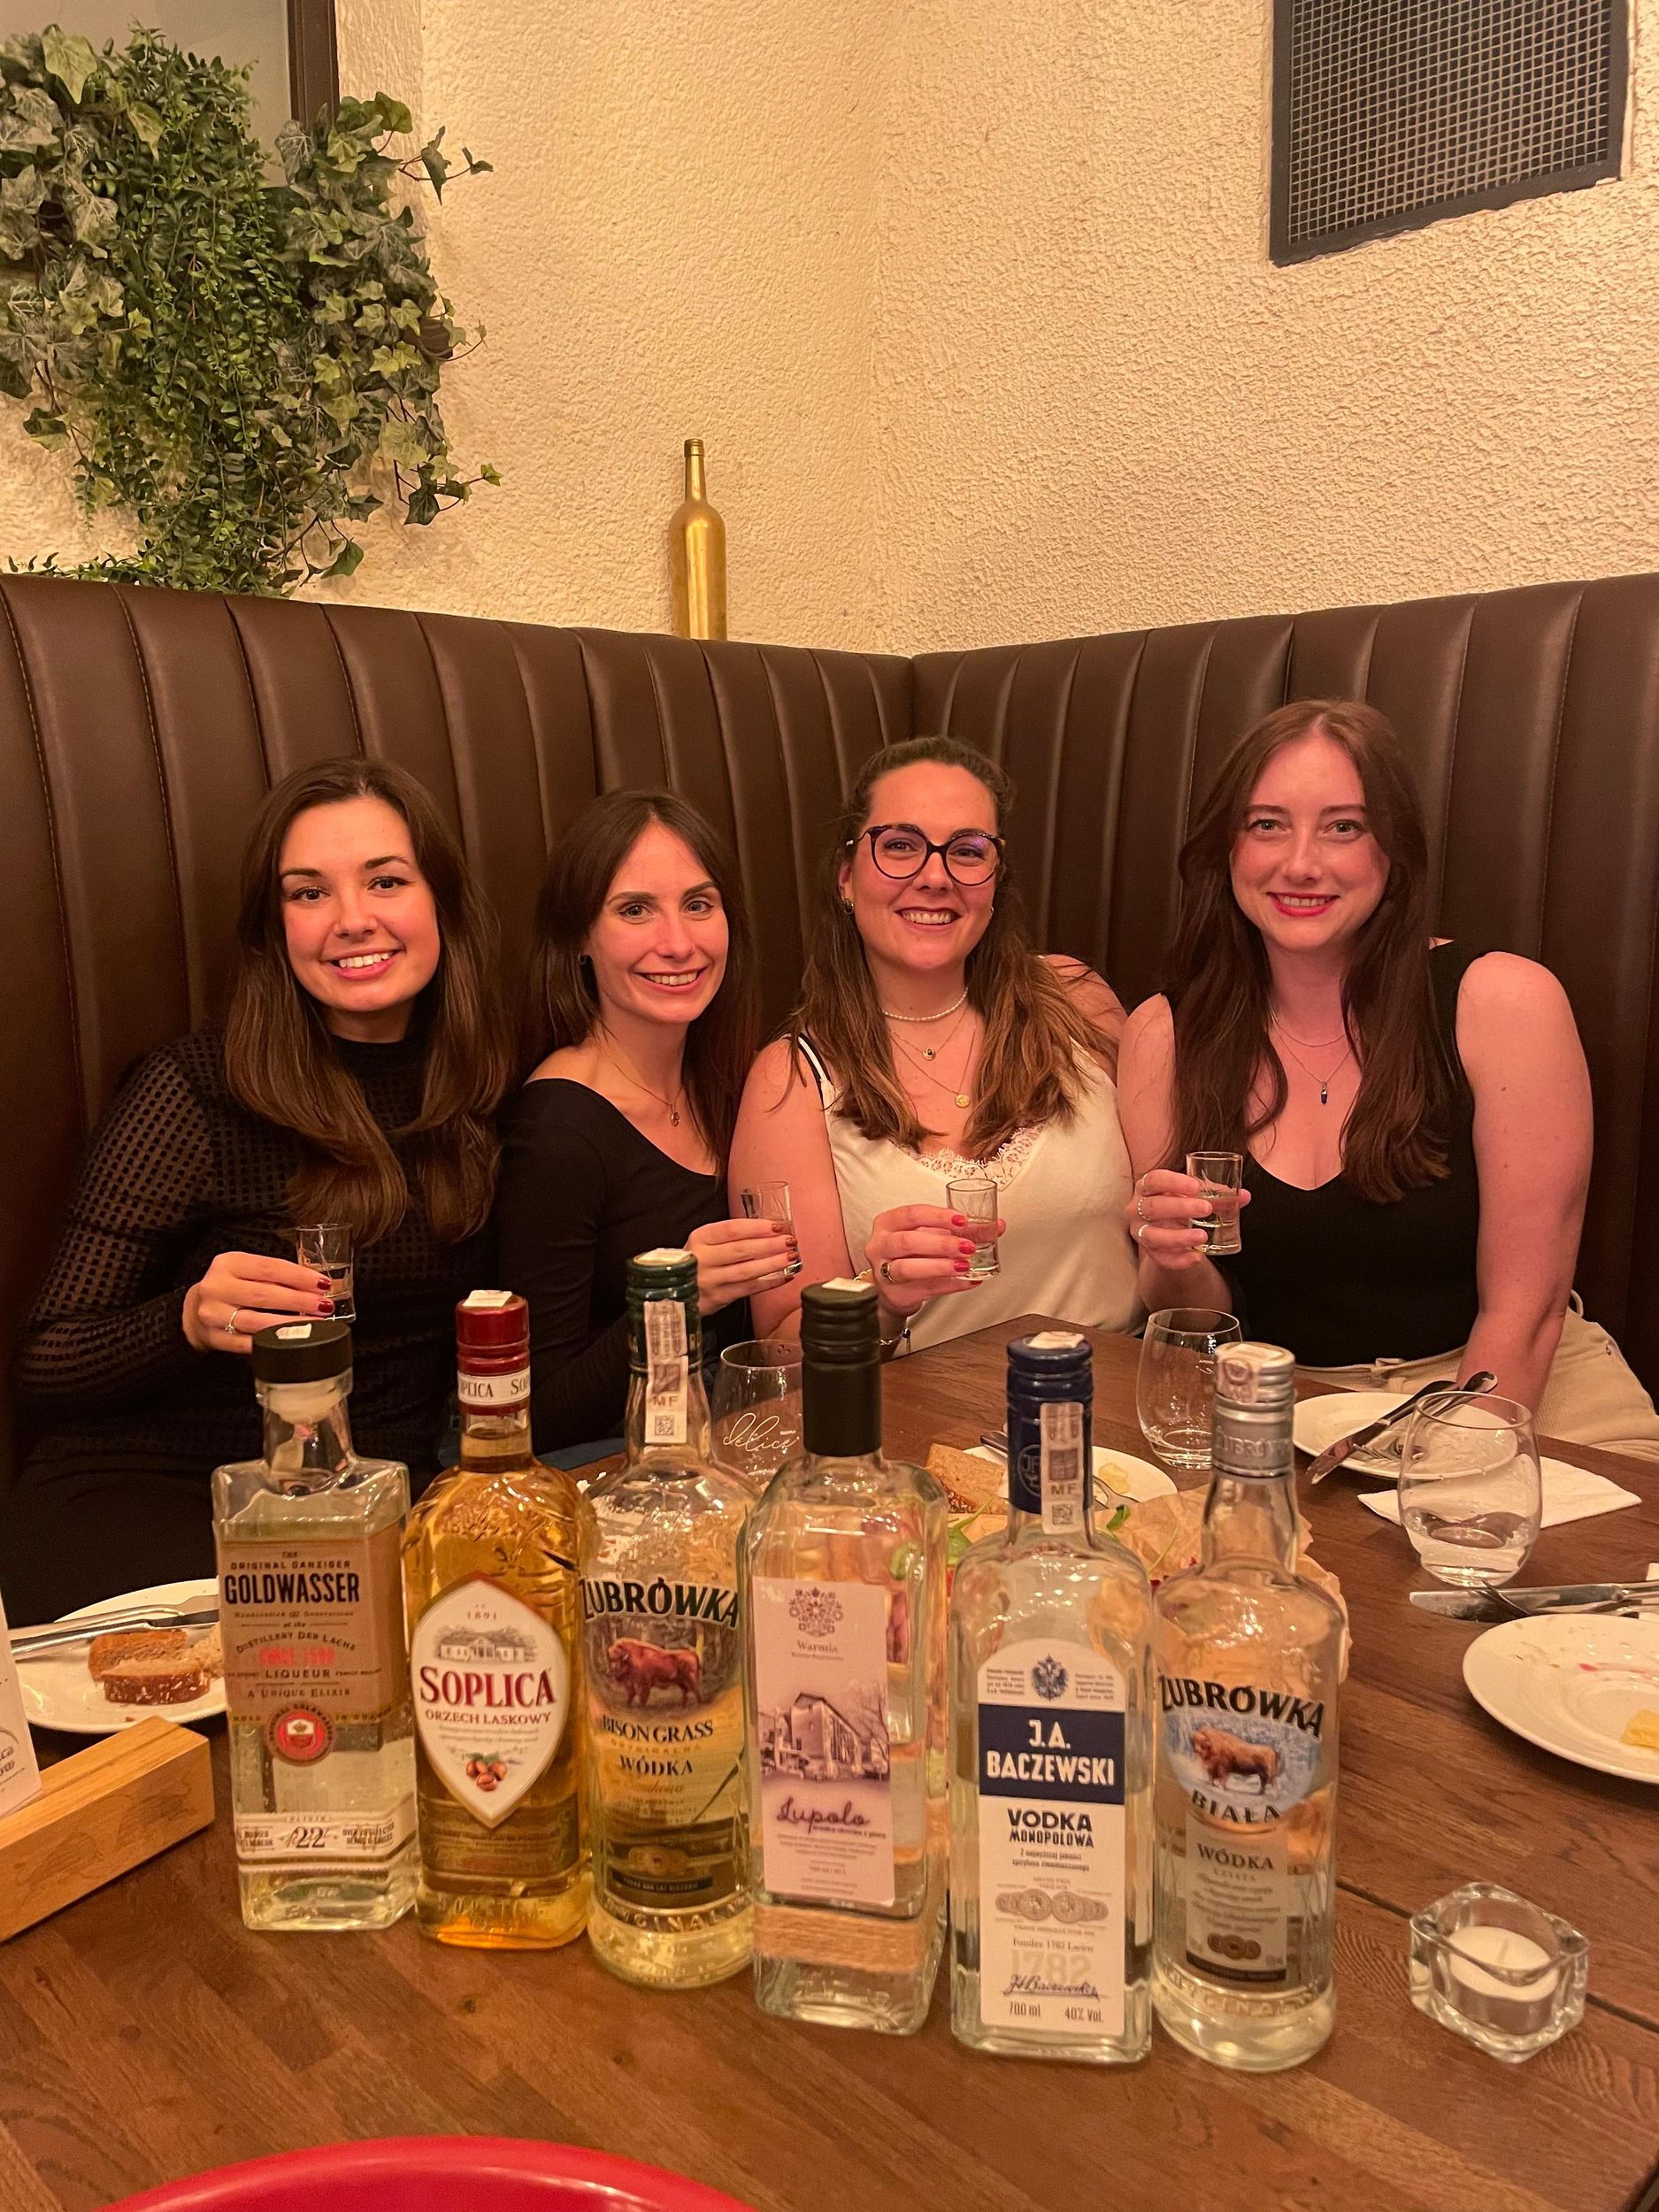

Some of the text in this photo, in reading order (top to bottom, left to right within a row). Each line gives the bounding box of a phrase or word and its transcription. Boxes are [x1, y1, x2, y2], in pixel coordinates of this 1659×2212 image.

[225, 1573, 359, 1604] GOLDWASSER
[265, 1670, 331, 1678] LIQUEUR
[419, 1665, 556, 1709] SOPLICA
[426, 1709, 552, 1724] ORZECH LASKOWY
[603, 1715, 713, 1743] BISON GRASS
[1028, 1719, 1071, 1749] J.A.
[619, 1755, 693, 1777] WÓDKA
[987, 1750, 1115, 1786] BACZEWSKI
[1007, 1808, 1093, 1832] VODKA
[296, 1826, 325, 1848] 22
[1009, 1829, 1094, 1848] MONOPOLOWA
[1196, 1843, 1274, 1870] WÓDKA
[1009, 2001, 1041, 2017] 700 ml
[1064, 2008, 1085, 2021] 40%
